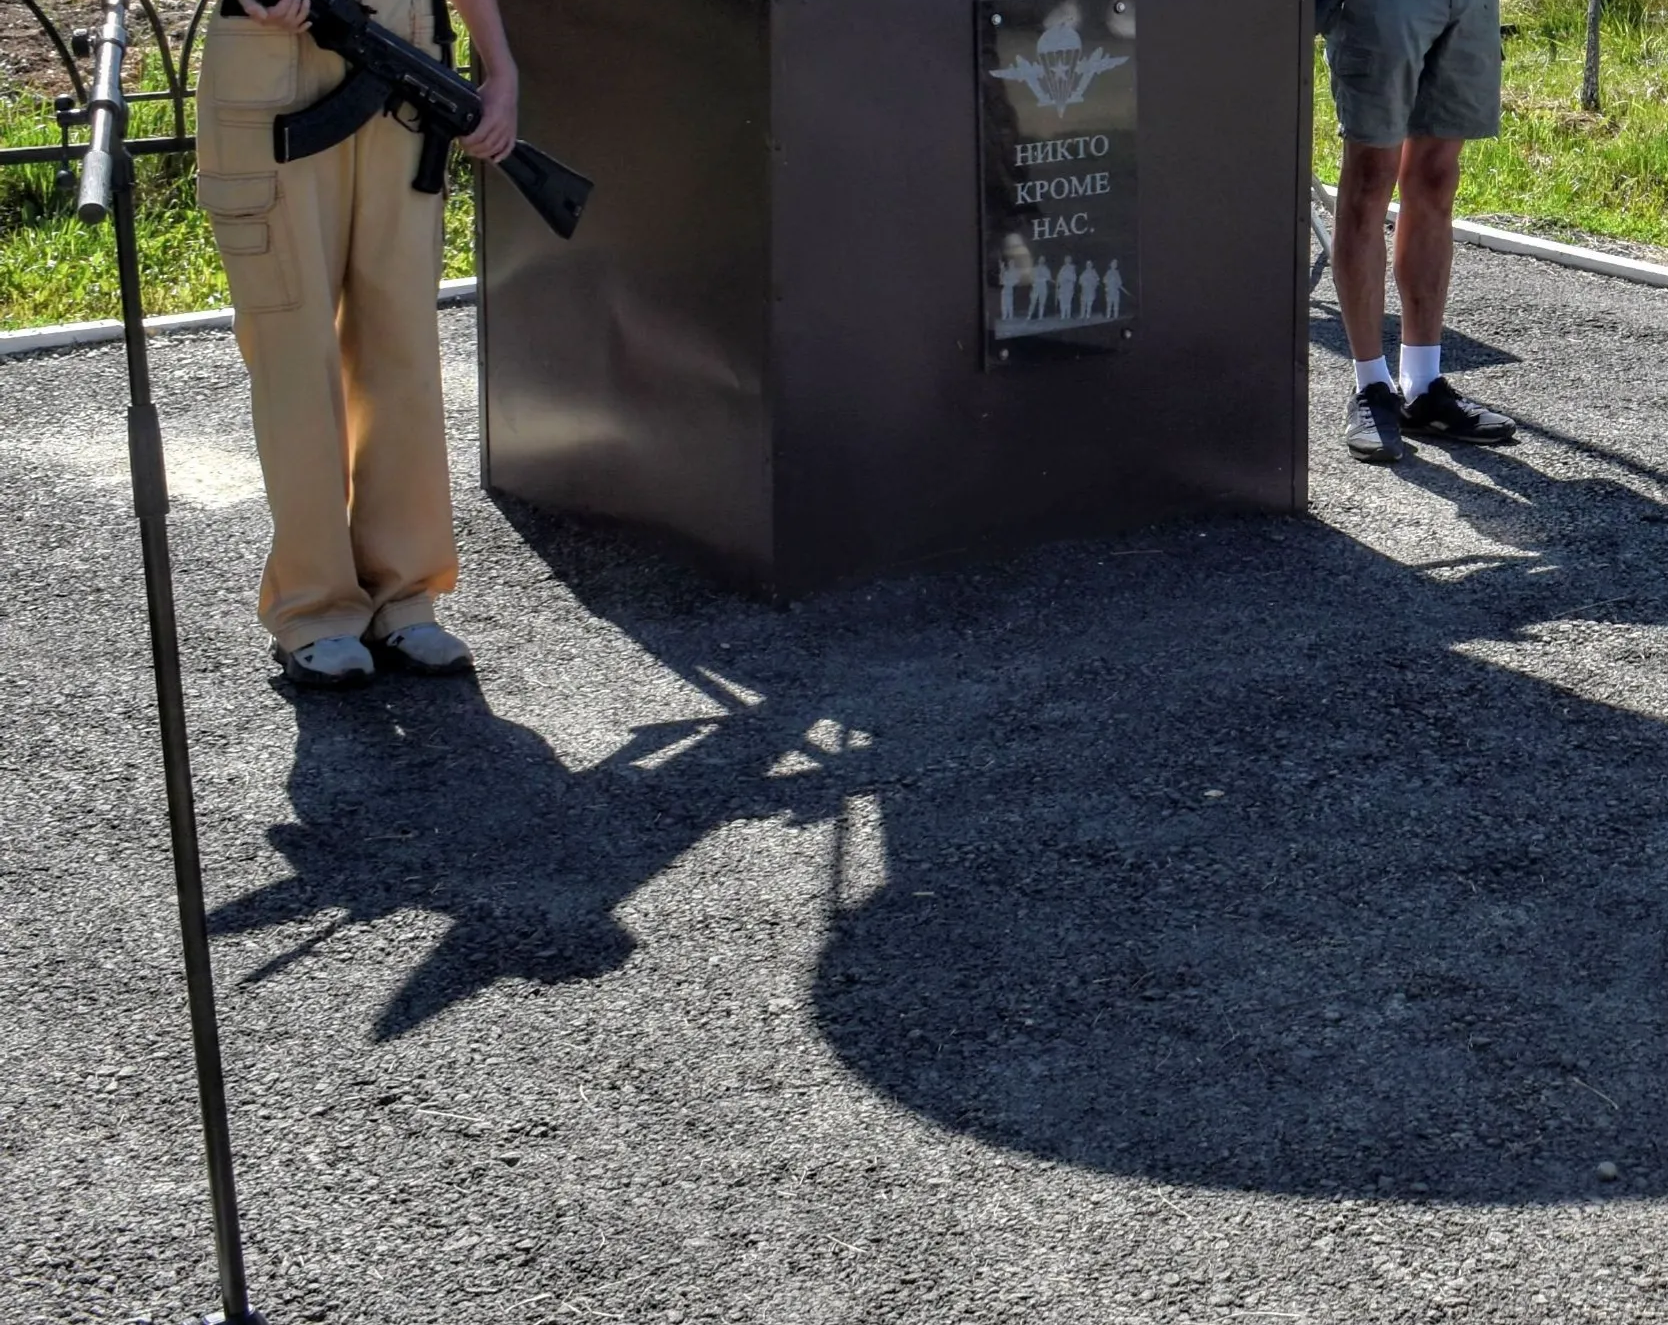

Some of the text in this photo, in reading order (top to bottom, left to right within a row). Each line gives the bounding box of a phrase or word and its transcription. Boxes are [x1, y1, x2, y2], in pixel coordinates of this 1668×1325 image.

[1014, 134, 1109, 166] НИКТО
[1014, 172, 1111, 205] КРОМЕ
[1031, 212, 1095, 241] НАС.
